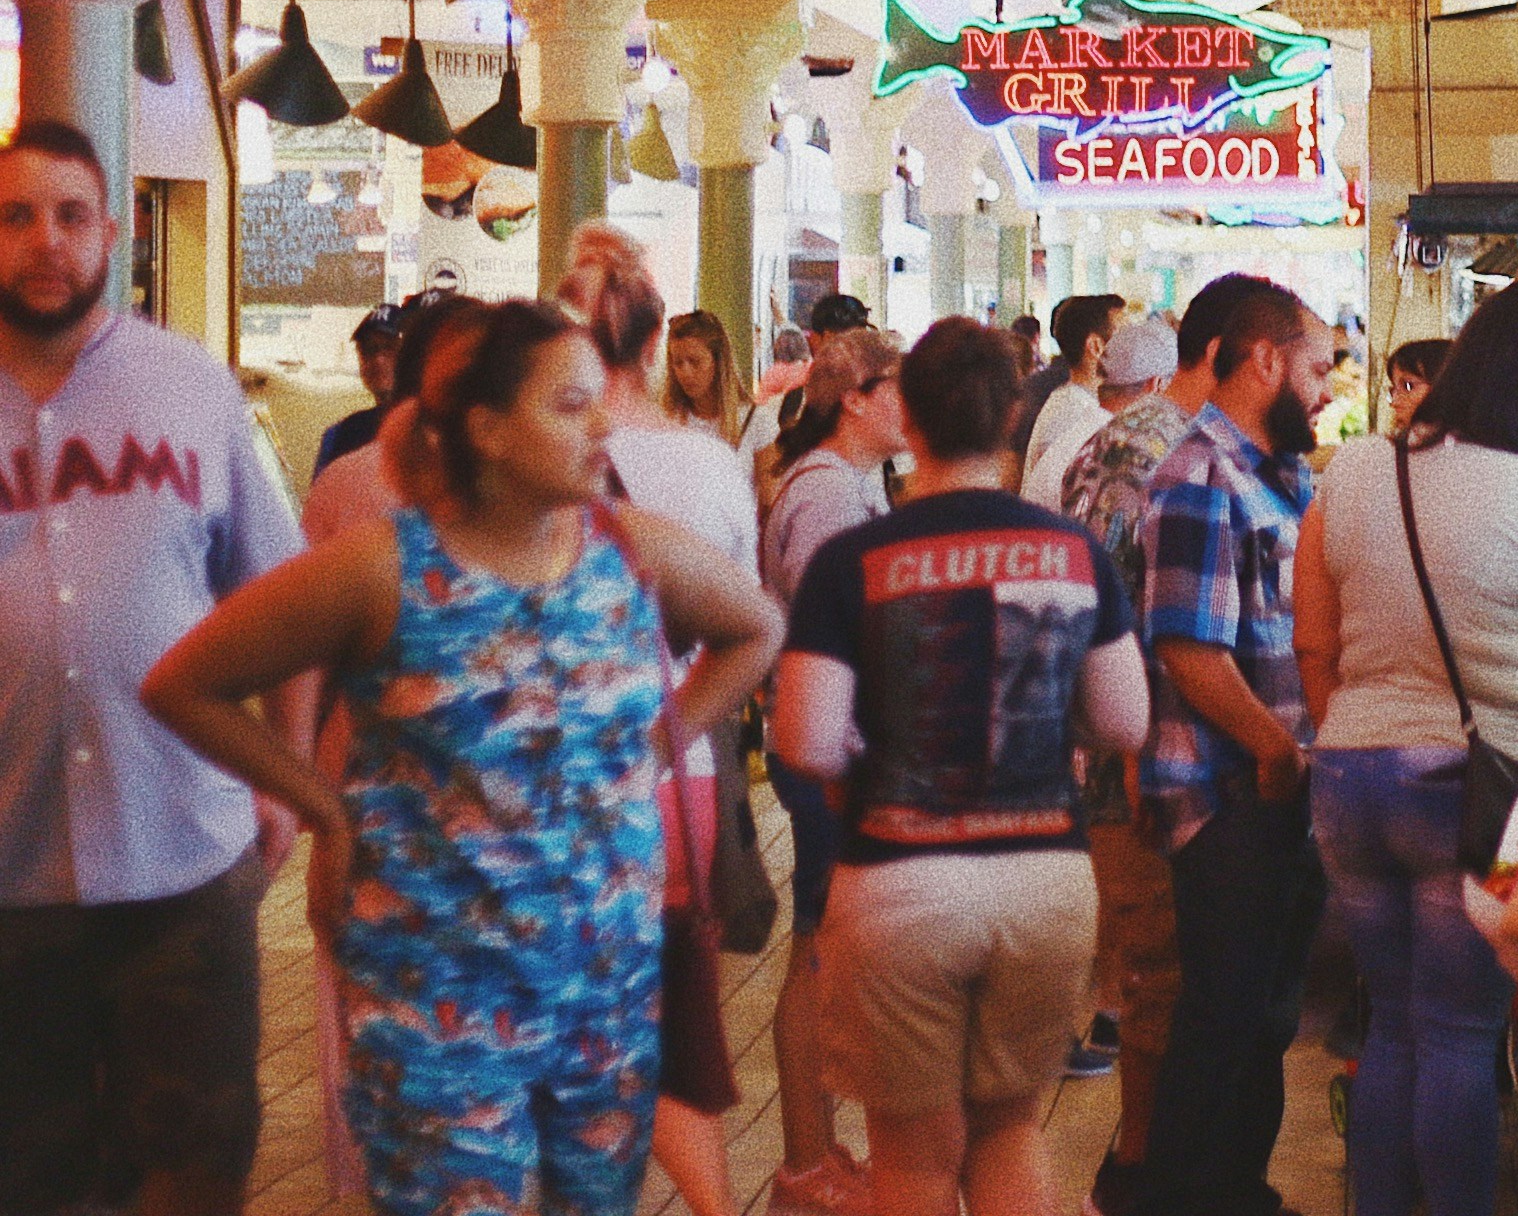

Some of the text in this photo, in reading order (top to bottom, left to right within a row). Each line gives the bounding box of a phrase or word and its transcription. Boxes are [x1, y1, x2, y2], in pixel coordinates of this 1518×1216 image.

[960, 26, 1254, 71] MARKET
[1003, 72, 1215, 118] GRILL
[1055, 137, 1281, 185] SEAFOOD
[886, 541, 1070, 592] CLUTCH
